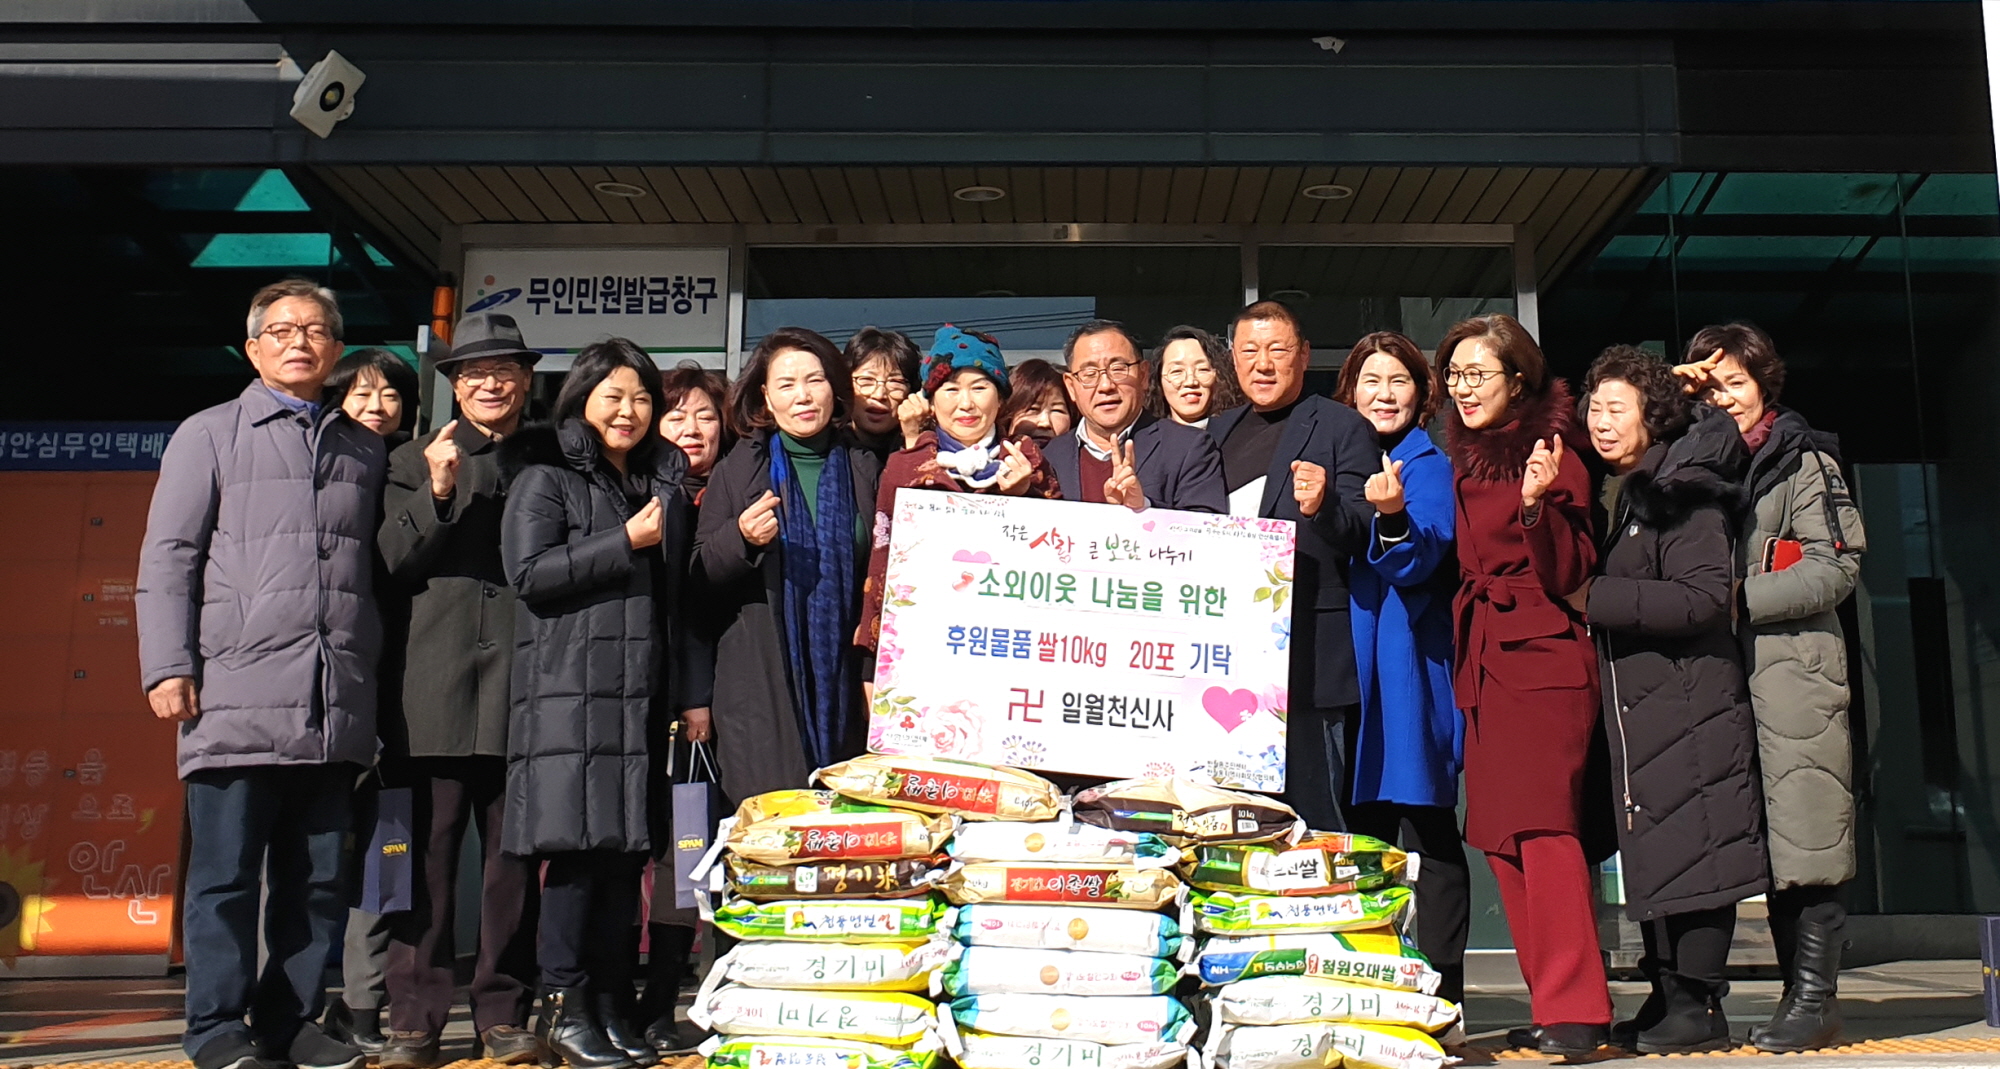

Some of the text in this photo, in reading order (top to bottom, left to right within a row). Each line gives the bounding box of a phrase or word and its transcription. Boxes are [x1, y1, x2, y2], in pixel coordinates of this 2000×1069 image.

[527, 276, 717, 315] 무인민원발급창구
[0, 432, 171, 459] 안심무인택배
[1002, 525, 1192, 565] 작은 사랑 큰 보람 나누기
[977, 568, 1227, 617] 소외이웃 나눔을 위한
[946, 624, 1032, 659] 후원물품
[1130, 640, 1175, 672] 20포
[1190, 642, 1232, 675] 기탁
[1062, 690, 1174, 732] 일월천신사
[382, 844, 407, 854] SPAM
[678, 839, 703, 849] SPAM
[805, 955, 885, 979] 경기미
[1211, 965, 1229, 974] NH
[778, 1002, 858, 1029] 경기미
[1303, 992, 1380, 1017] 경기미
